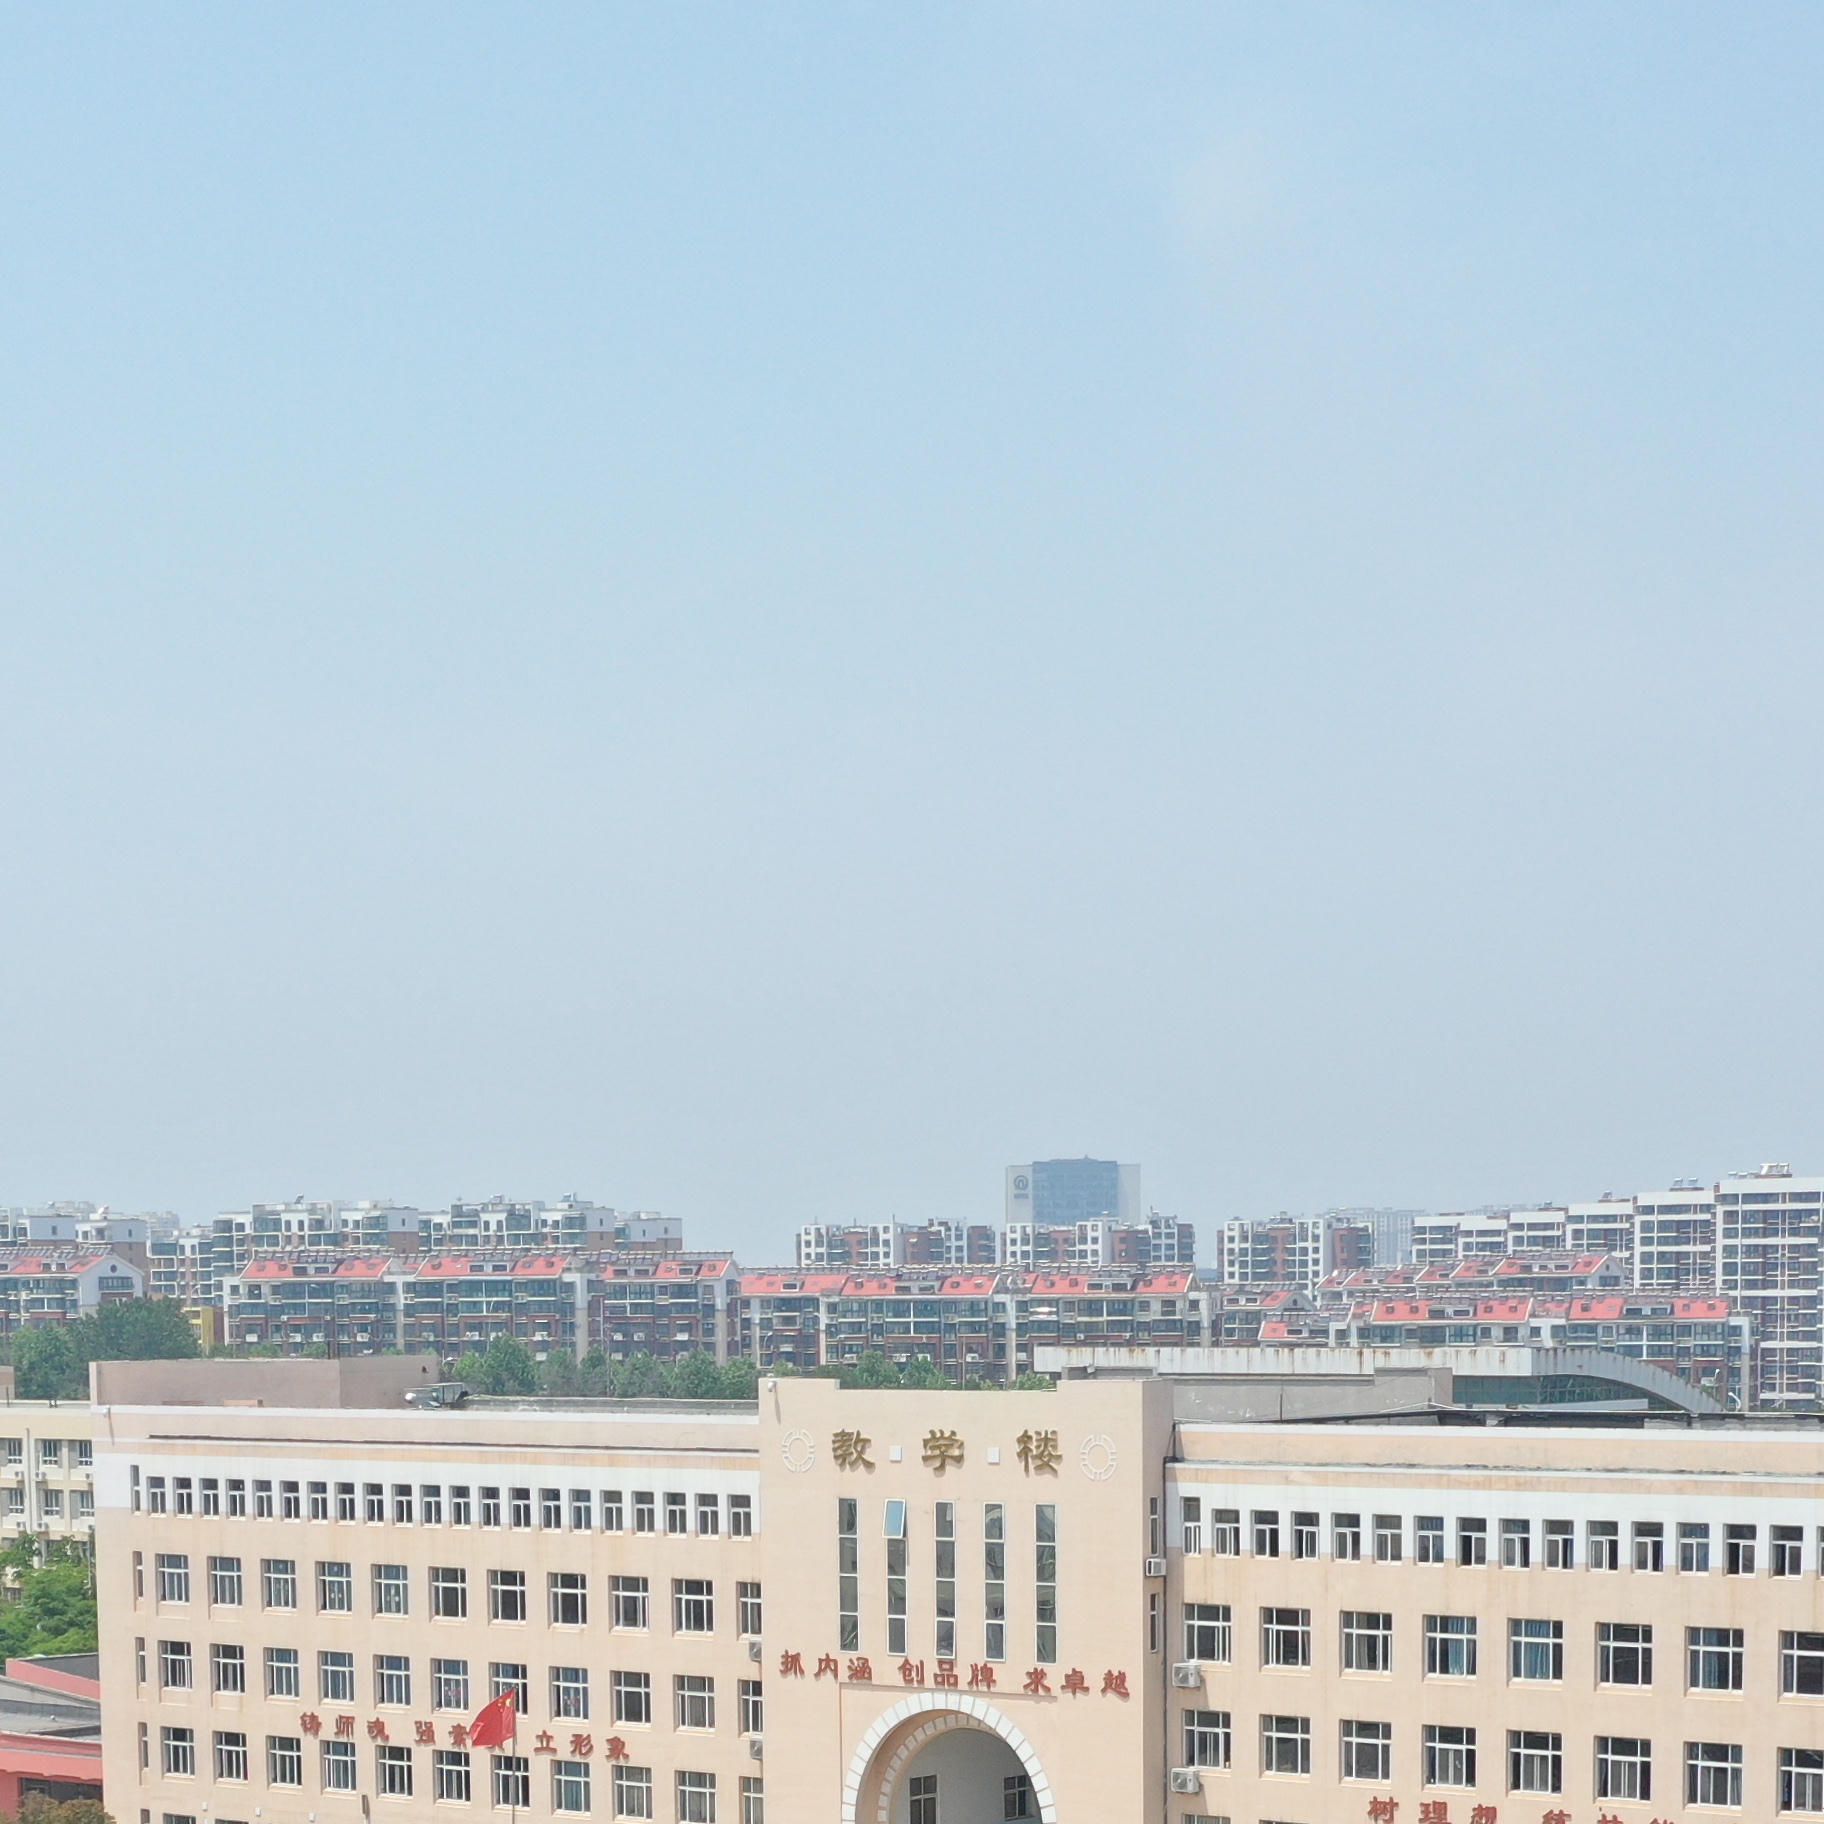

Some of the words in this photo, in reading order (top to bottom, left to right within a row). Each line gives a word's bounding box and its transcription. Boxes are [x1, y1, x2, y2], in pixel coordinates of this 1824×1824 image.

[832, 1429, 1063, 1477] 教学楼
[780, 1650, 873, 1683] 抓内涵
[898, 1658, 996, 1689] 创品牌
[1023, 1667, 1130, 1698] 求卓越
[300, 1711, 390, 1741] 铸师魂
[414, 1720, 505, 1750] 强素
[534, 1730, 630, 1760] 立形象
